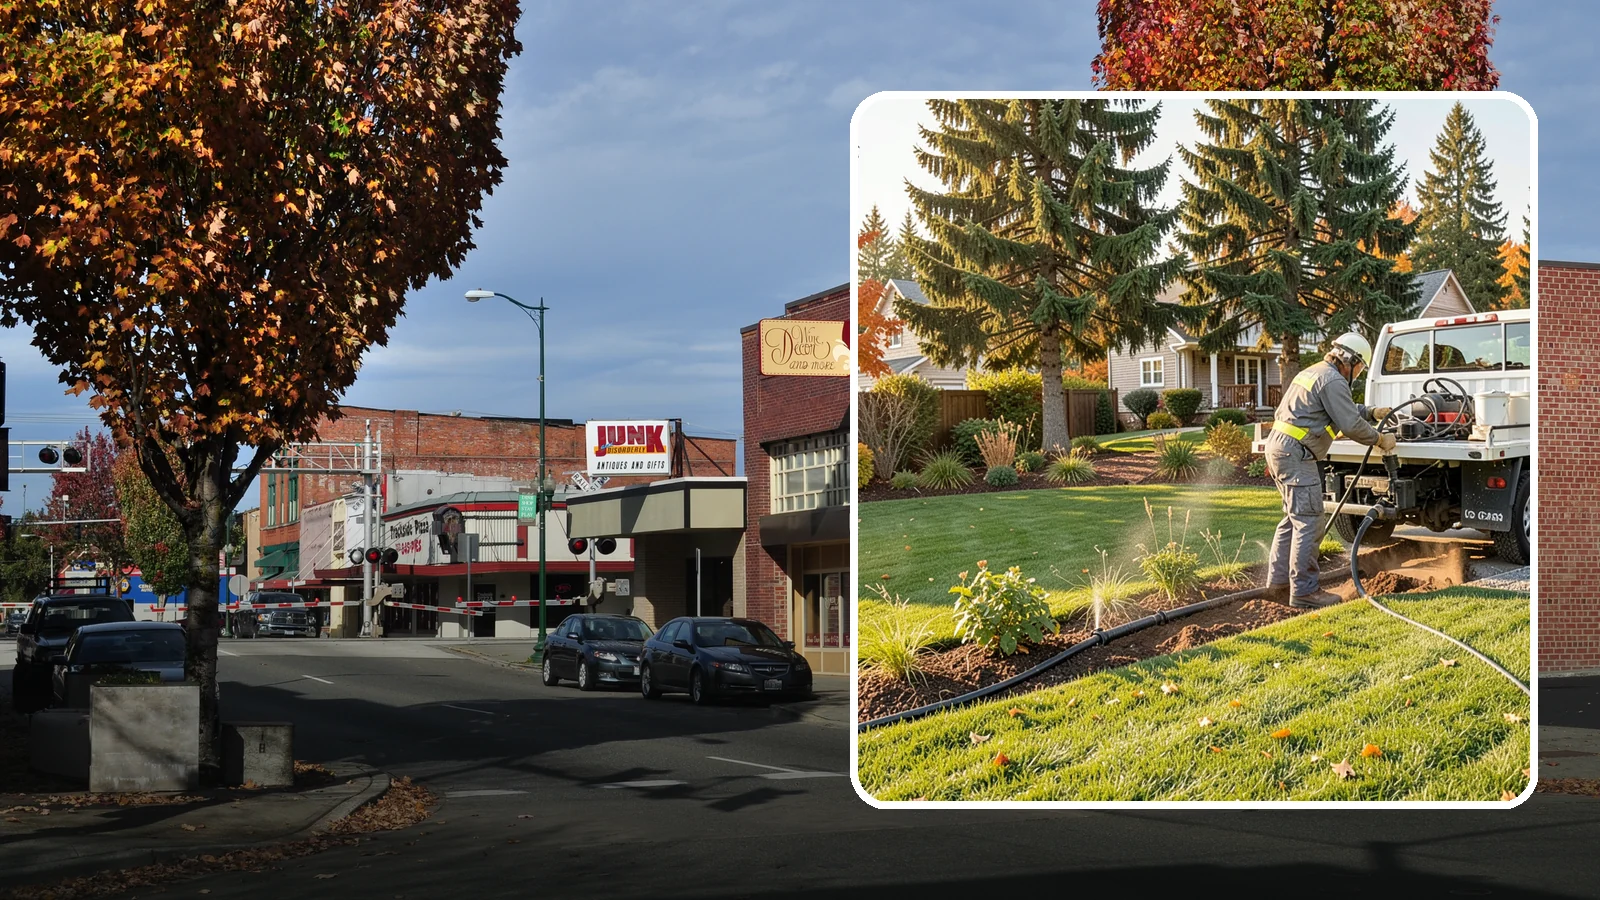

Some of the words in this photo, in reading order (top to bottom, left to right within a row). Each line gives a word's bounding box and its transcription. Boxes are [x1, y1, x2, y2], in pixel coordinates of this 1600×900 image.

[595, 425, 665, 457] JUNK
[607, 446, 647, 454] DISORDERLY
[596, 461, 628, 470] ANTIQUES
[631, 461, 644, 470] AND
[647, 460, 665, 470] GIFTS
[414, 519, 429, 535] Pizza
